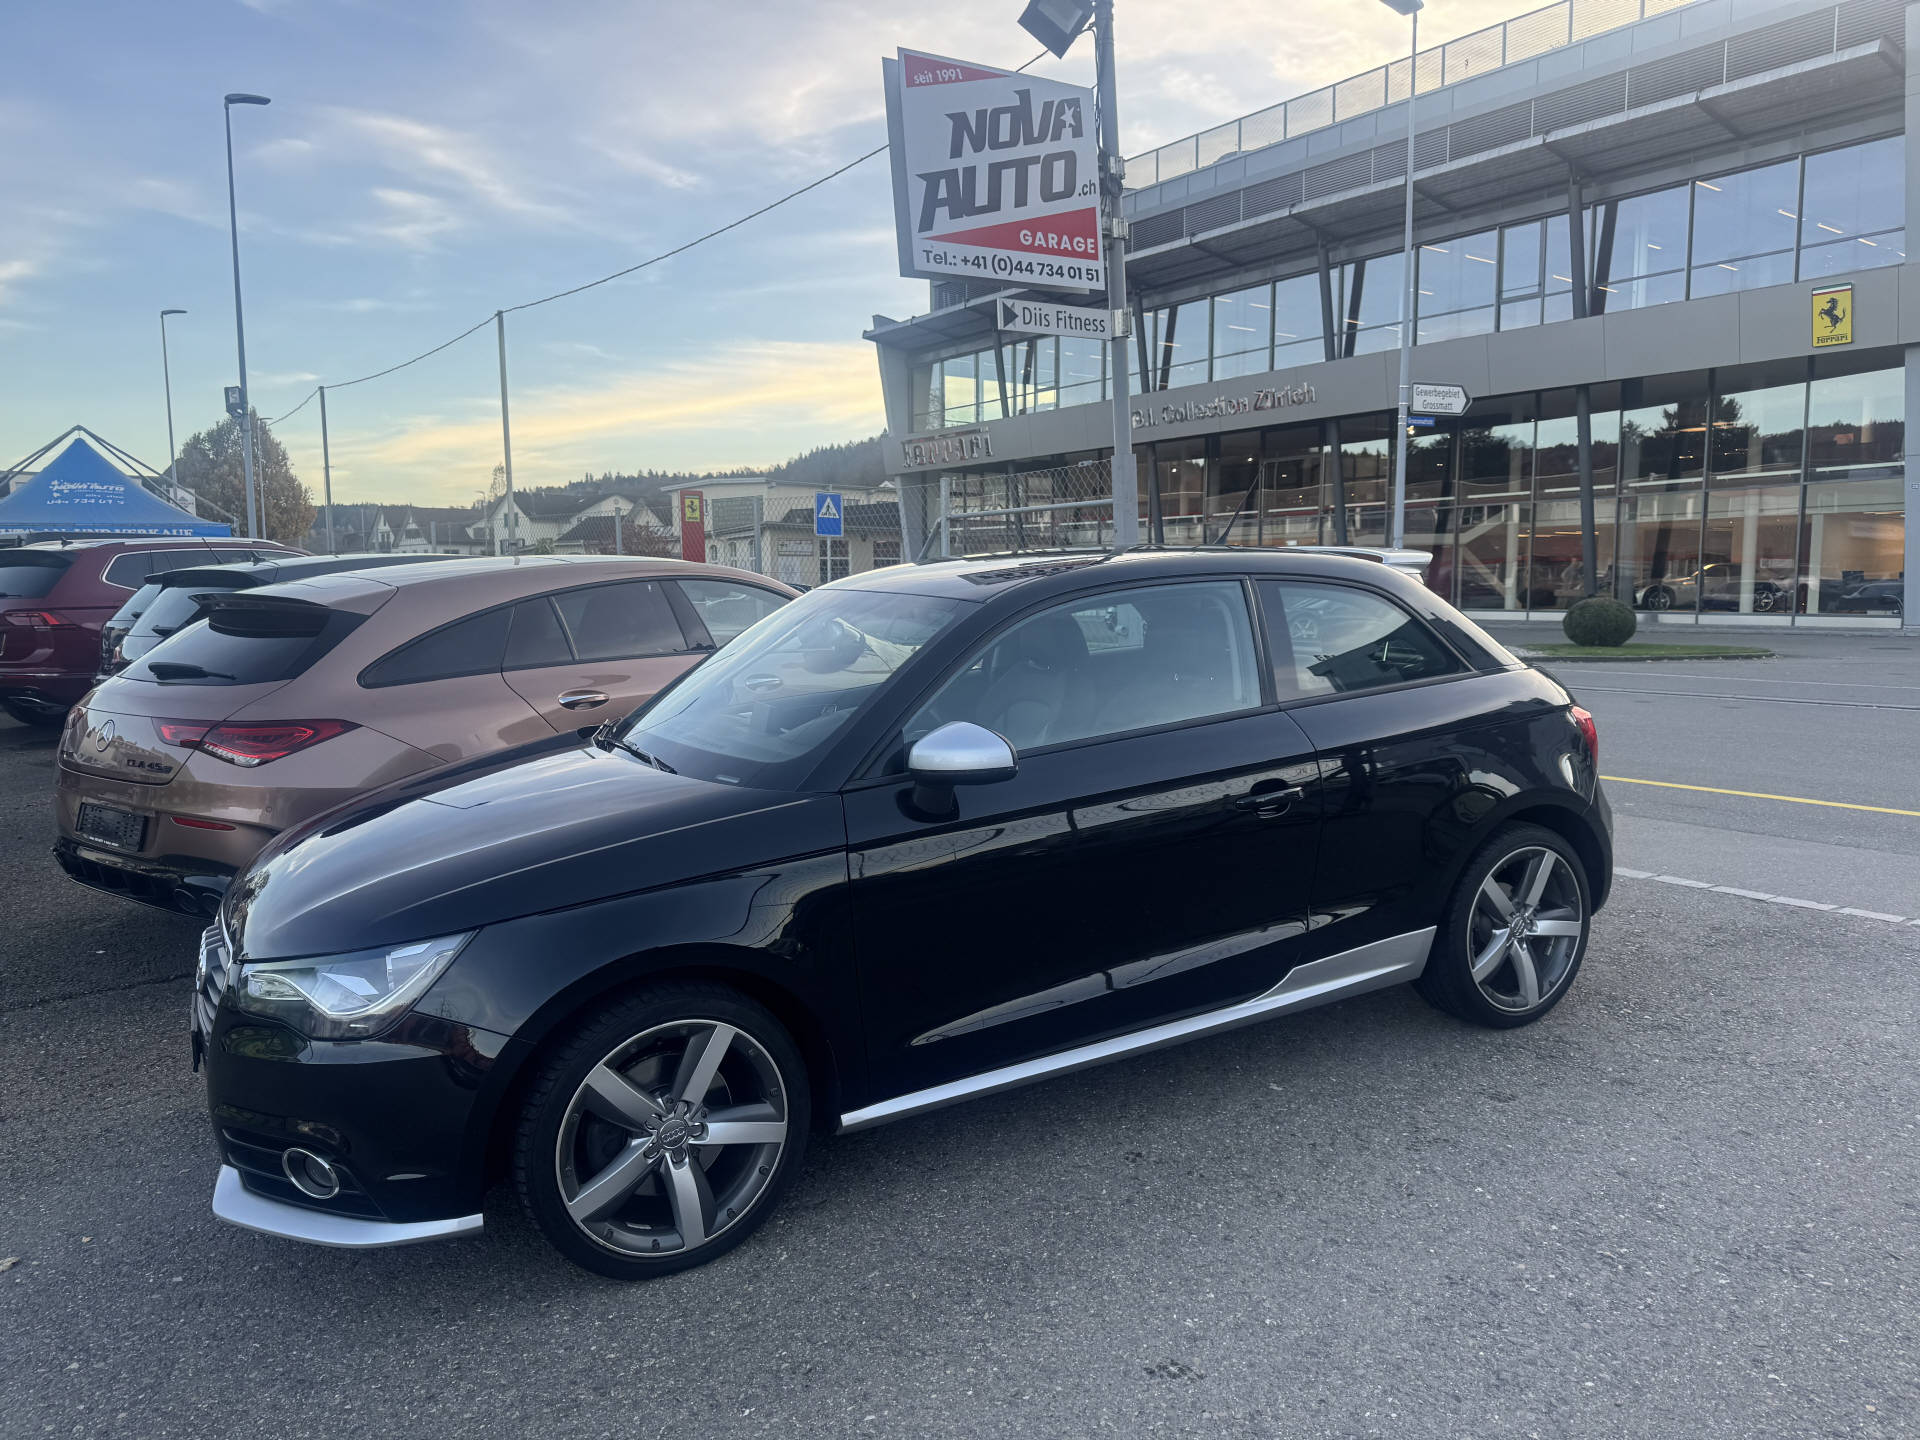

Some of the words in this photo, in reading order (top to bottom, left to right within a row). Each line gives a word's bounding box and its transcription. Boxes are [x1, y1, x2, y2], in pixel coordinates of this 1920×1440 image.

[914, 71, 933, 85] seit
[935, 68, 963, 83] 1991
[944, 89, 1083, 159] NOVA
[915, 150, 1077, 233] AUTO
[1019, 229, 1096, 254] GARAGE
[923, 249, 957, 267] Tel.:
[960, 254, 988, 271] +41
[991, 255, 1034, 277] (0)44
[1036, 262, 1065, 279] 734
[1067, 265, 1083, 281] 01
[1085, 268, 1100, 282] 51
[1022, 306, 1051, 328] Diis
[1056, 310, 1106, 333] Fitness
[1816, 333, 1849, 344] Ferrari
[1162, 396, 1249, 424] Collection
[1253, 382, 1316, 412] Zürich
[1415, 386, 1460, 400] Gewerbegebiet
